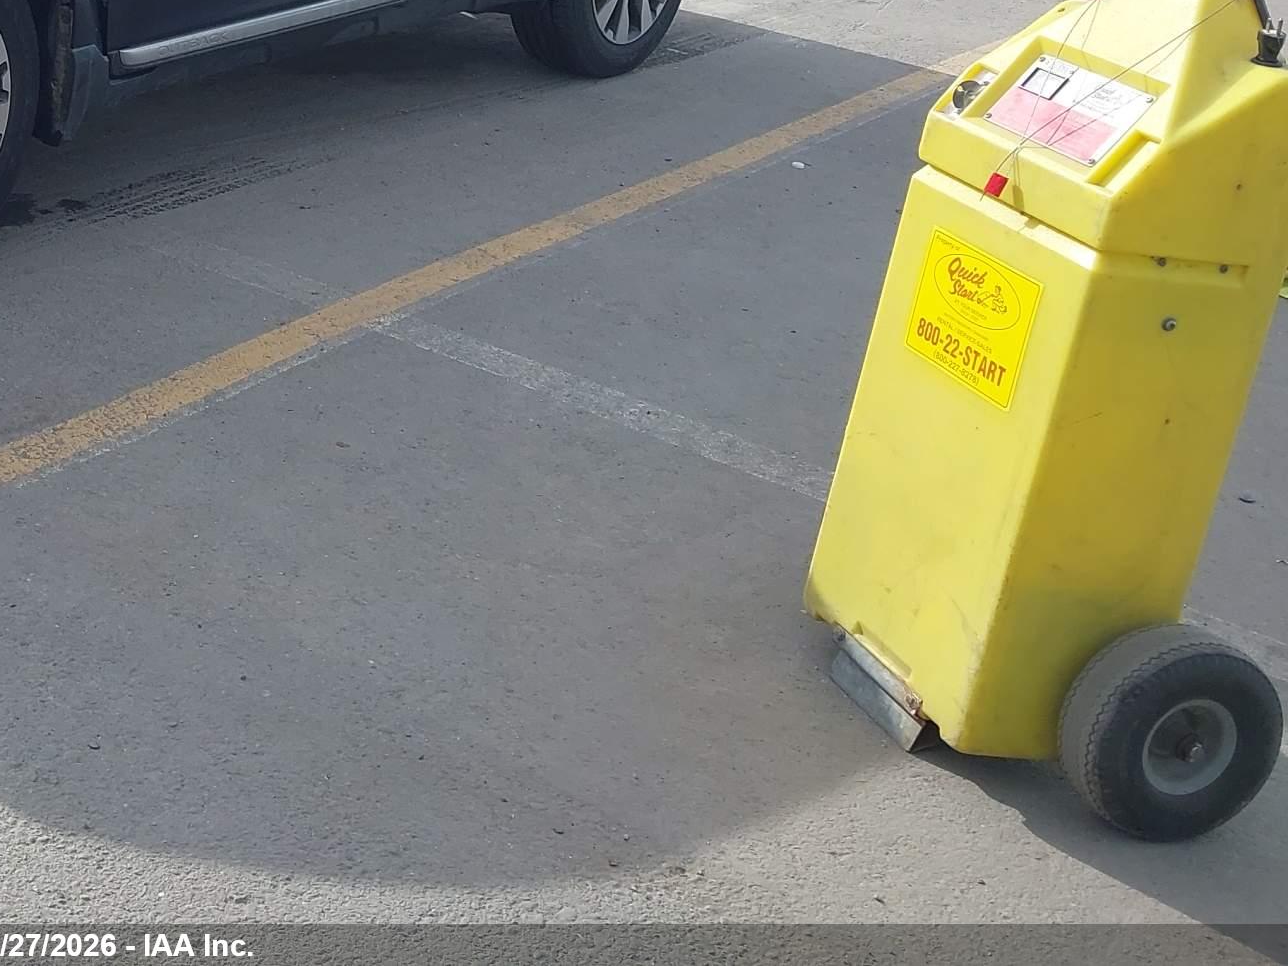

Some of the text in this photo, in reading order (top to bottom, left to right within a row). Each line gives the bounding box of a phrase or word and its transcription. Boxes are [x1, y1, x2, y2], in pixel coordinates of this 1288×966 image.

[158, 31, 232, 56] OUTBACK
[947, 257, 988, 289] Quick
[948, 279, 978, 302] Start
[917, 317, 1007, 387] 800-22-START
